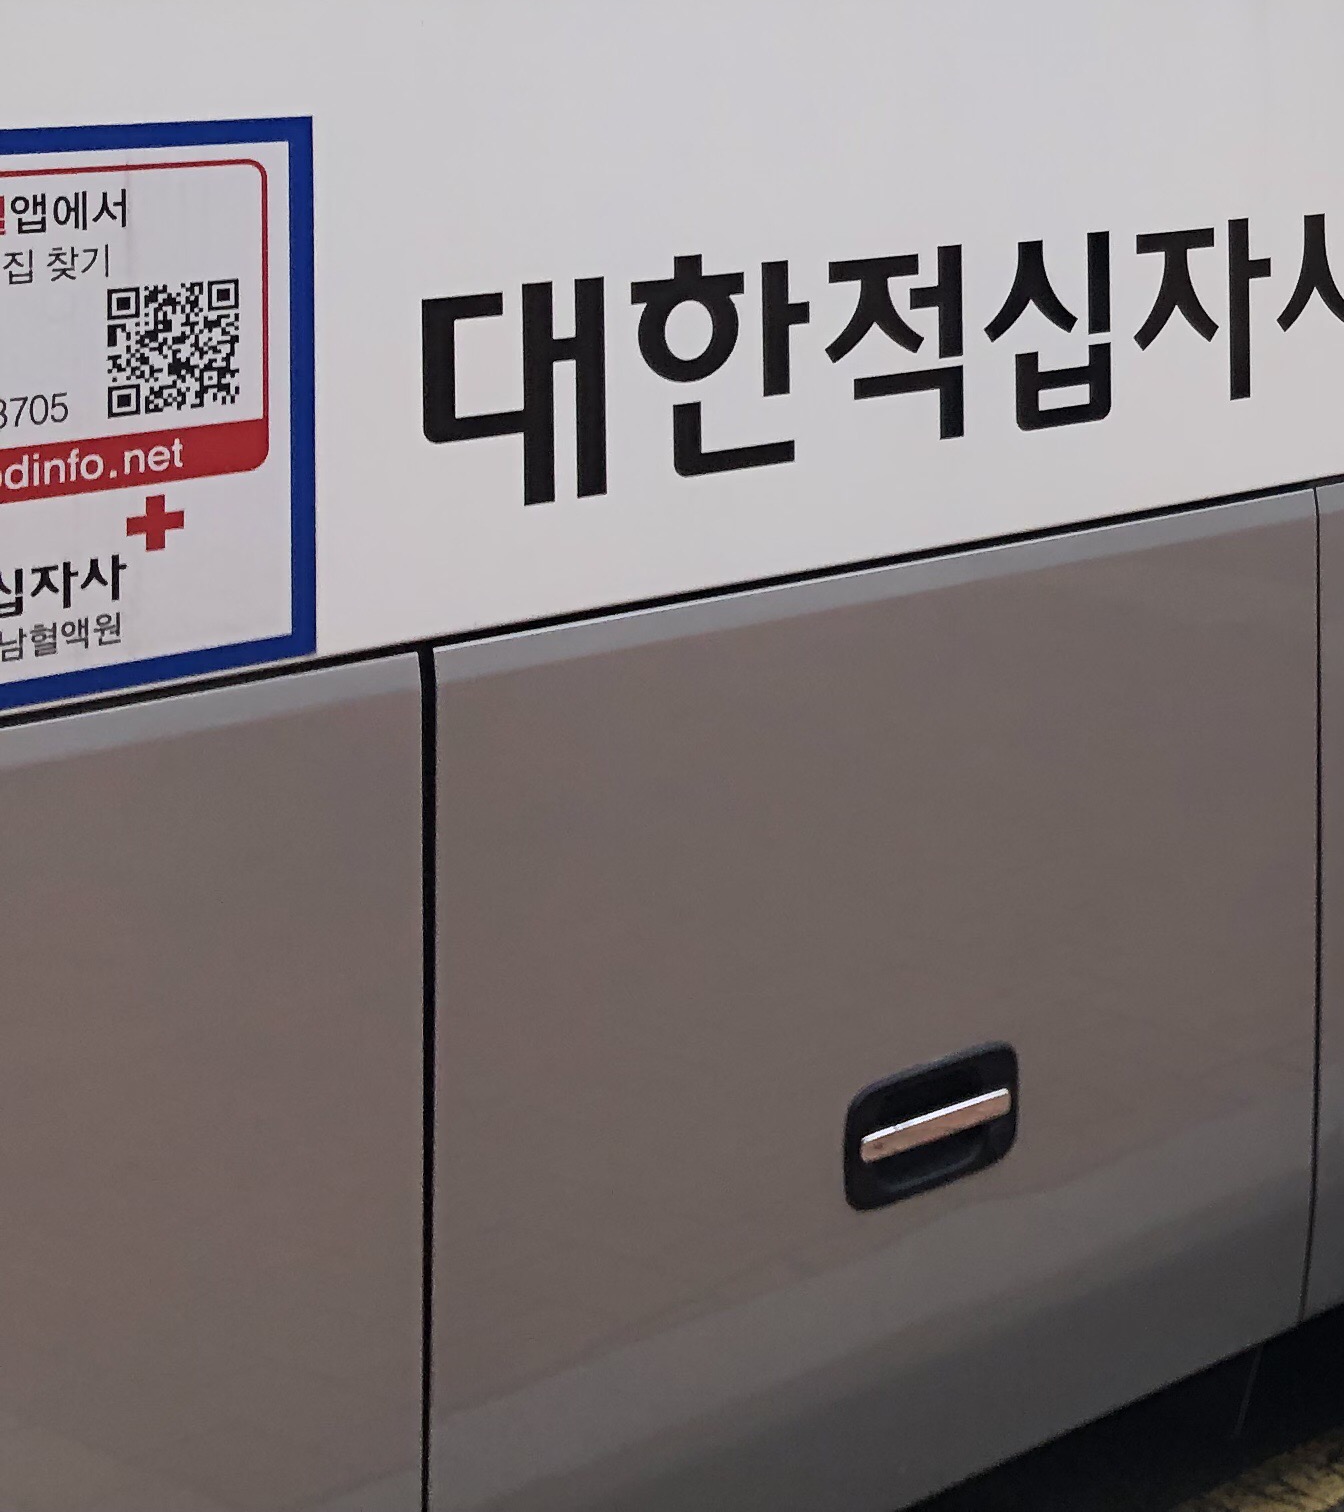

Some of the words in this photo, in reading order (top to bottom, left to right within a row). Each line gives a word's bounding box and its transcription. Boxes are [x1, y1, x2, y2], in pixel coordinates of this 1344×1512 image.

[0, 188, 128, 237] 앱에서
[46, 243, 110, 282] 찾기
[0, 437, 184, 491] dinfo.net
